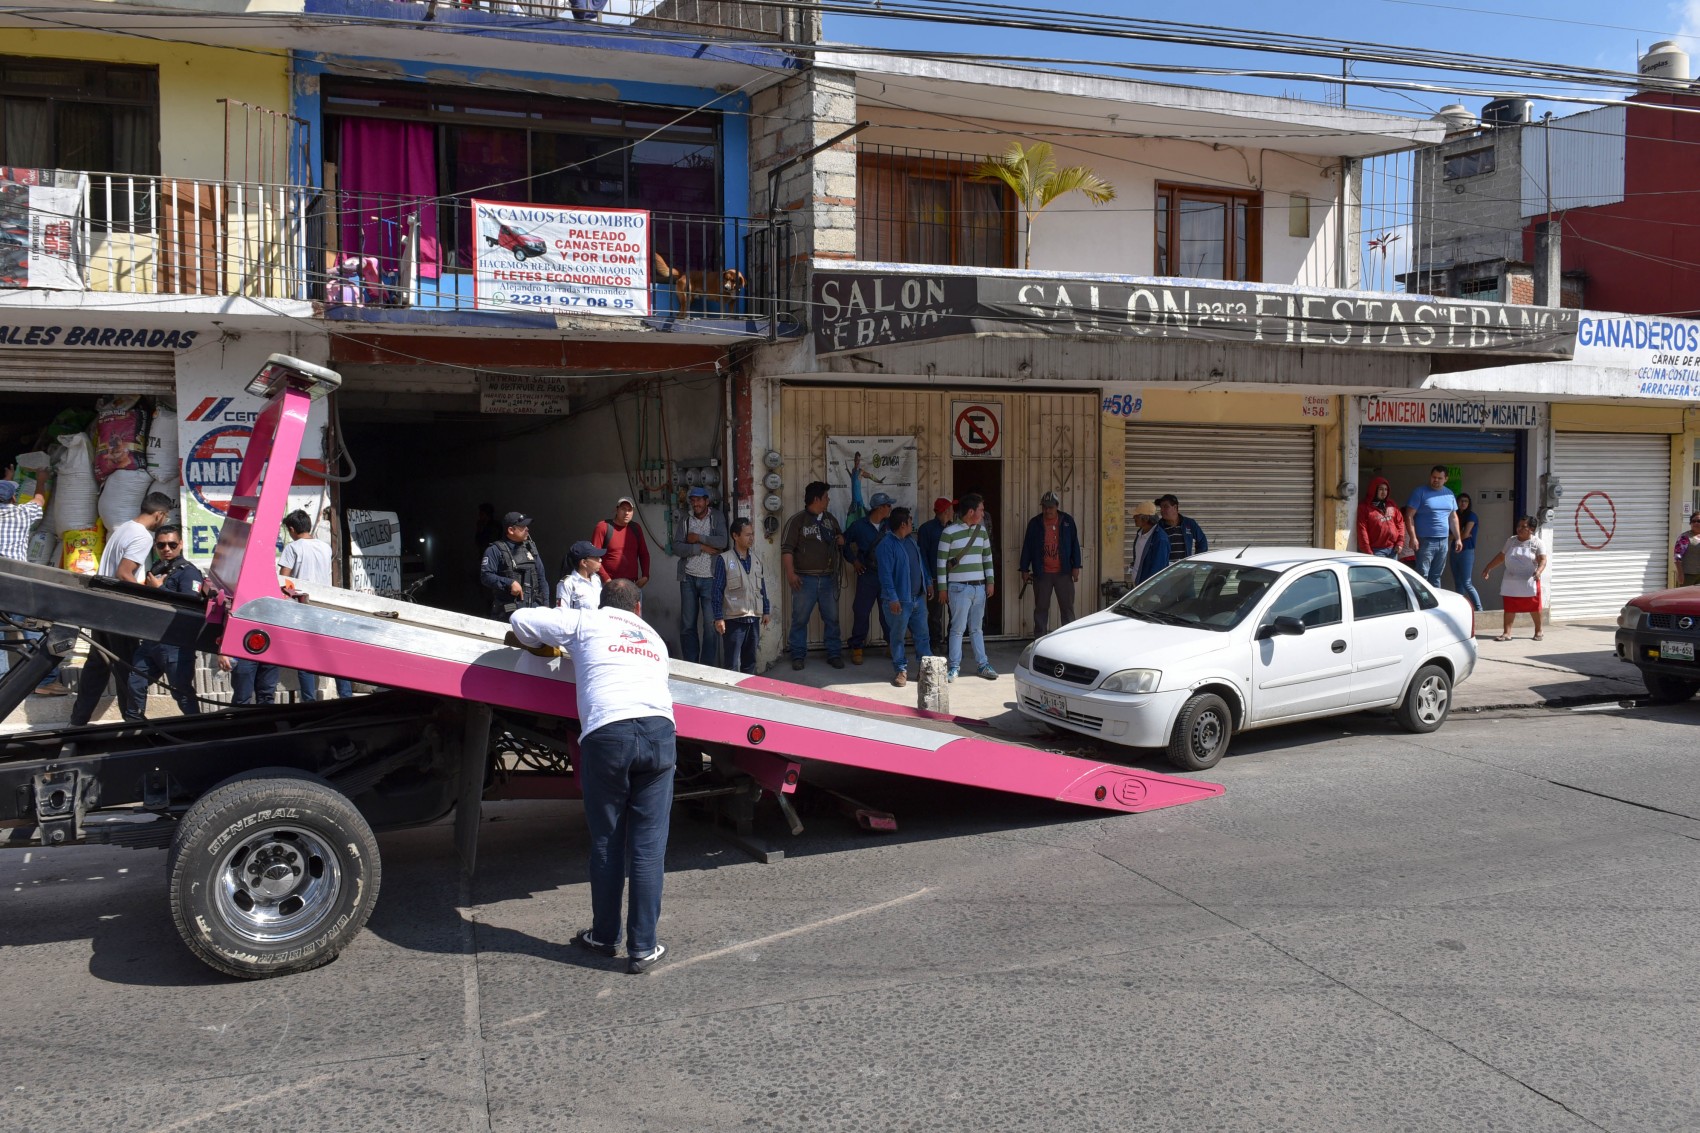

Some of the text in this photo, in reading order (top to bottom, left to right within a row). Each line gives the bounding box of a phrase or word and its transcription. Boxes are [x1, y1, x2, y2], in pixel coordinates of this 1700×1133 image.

[478, 207, 644, 228] SACAMOS ESCOMBRO
[569, 229, 626, 241] PALEADO
[554, 240, 641, 253] CANASTEADO
[560, 252, 636, 264] Y POR LONA
[479, 259, 645, 277] HACEMOS REBAJES CON MAQUINA
[493, 270, 632, 286] FLETES ECONOMICOS
[500, 282, 628, 297] Alejandro Barradas Hernandez
[510, 294, 634, 309] 2281 97 08 95
[821, 278, 946, 322] SALON
[1018, 284, 1190, 337] SALON
[1196, 299, 1247, 323] para
[1255, 294, 1437, 347] FIESTAS
[63, 326, 199, 349] BARRADAS
[1578, 318, 1700, 352] GANADEROS
[1651, 355, 1680, 365] CARNE
[1682, 356, 1693, 366] DE
[1638, 367, 1666, 380] CECINA
[1640, 382, 1690, 396] ARRACHERA
[224, 411, 259, 422] CEM
[1367, 401, 1426, 423] CARNICERIA
[1429, 402, 1485, 424] GANADEROS
[1492, 404, 1537, 426] MISANTLA
[354, 573, 393, 590] PINTURA
[608, 644, 661, 661] GARRIDO
[207, 807, 300, 855] GENERAL
